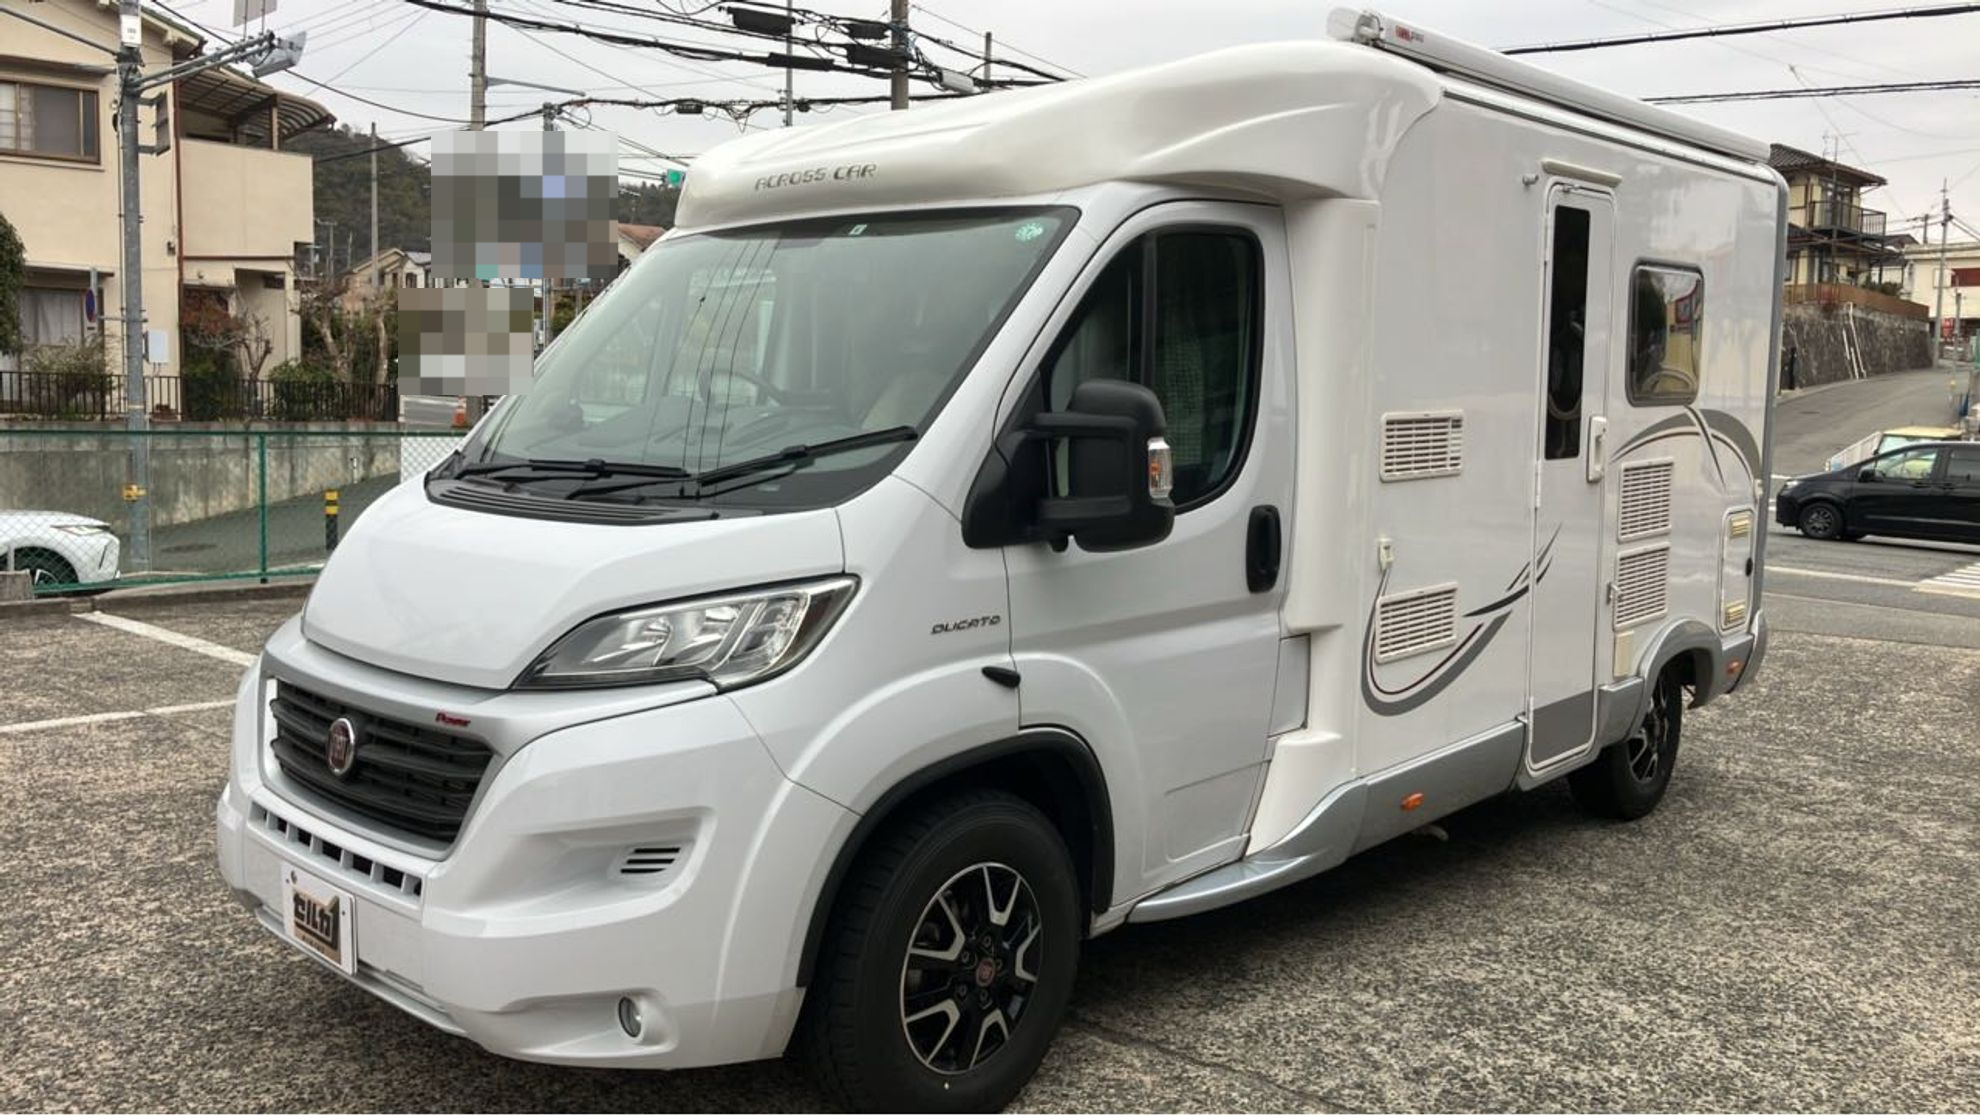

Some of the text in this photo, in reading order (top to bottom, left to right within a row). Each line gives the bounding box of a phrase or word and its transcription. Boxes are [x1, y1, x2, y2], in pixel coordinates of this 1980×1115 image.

[754, 163, 877, 191] ACROSS CAR
[930, 615, 1001, 635] DUCATO
